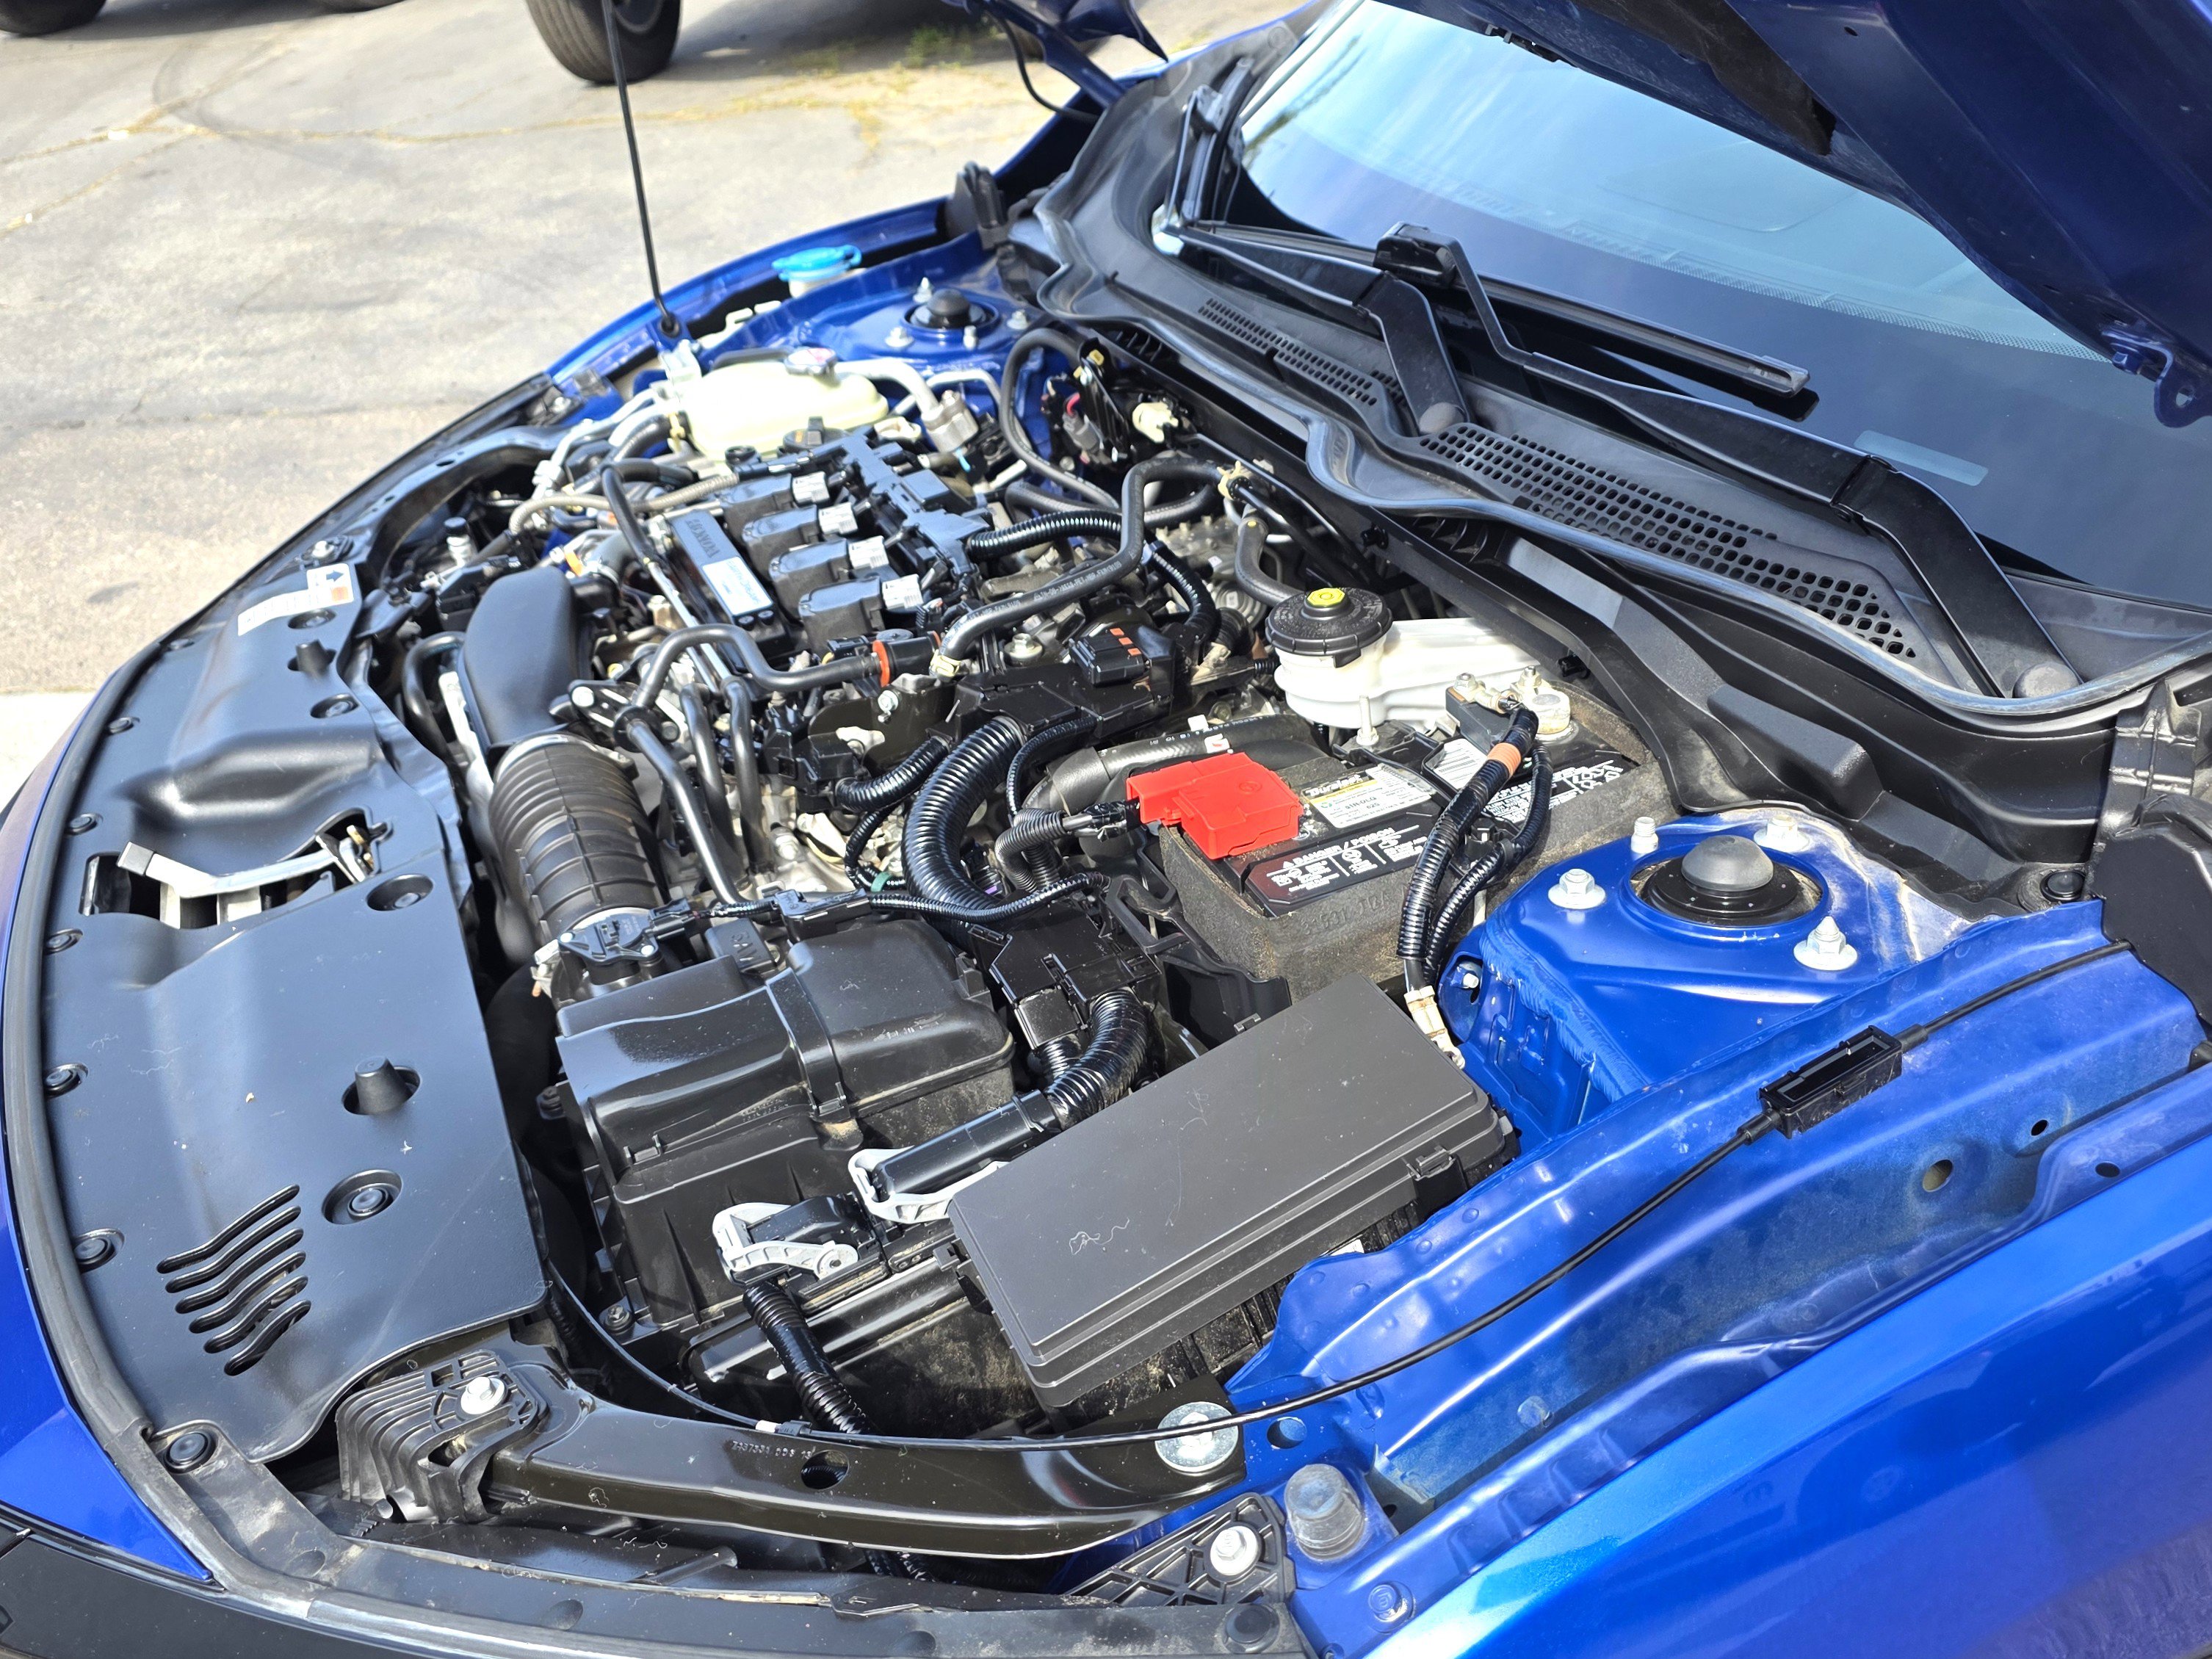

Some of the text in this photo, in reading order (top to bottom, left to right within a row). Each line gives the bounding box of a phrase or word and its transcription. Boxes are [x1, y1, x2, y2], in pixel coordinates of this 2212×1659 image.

[1305, 774, 1363, 797] Duralast
[1293, 845, 1342, 865] DANGER
[1351, 827, 1396, 847] POISON
